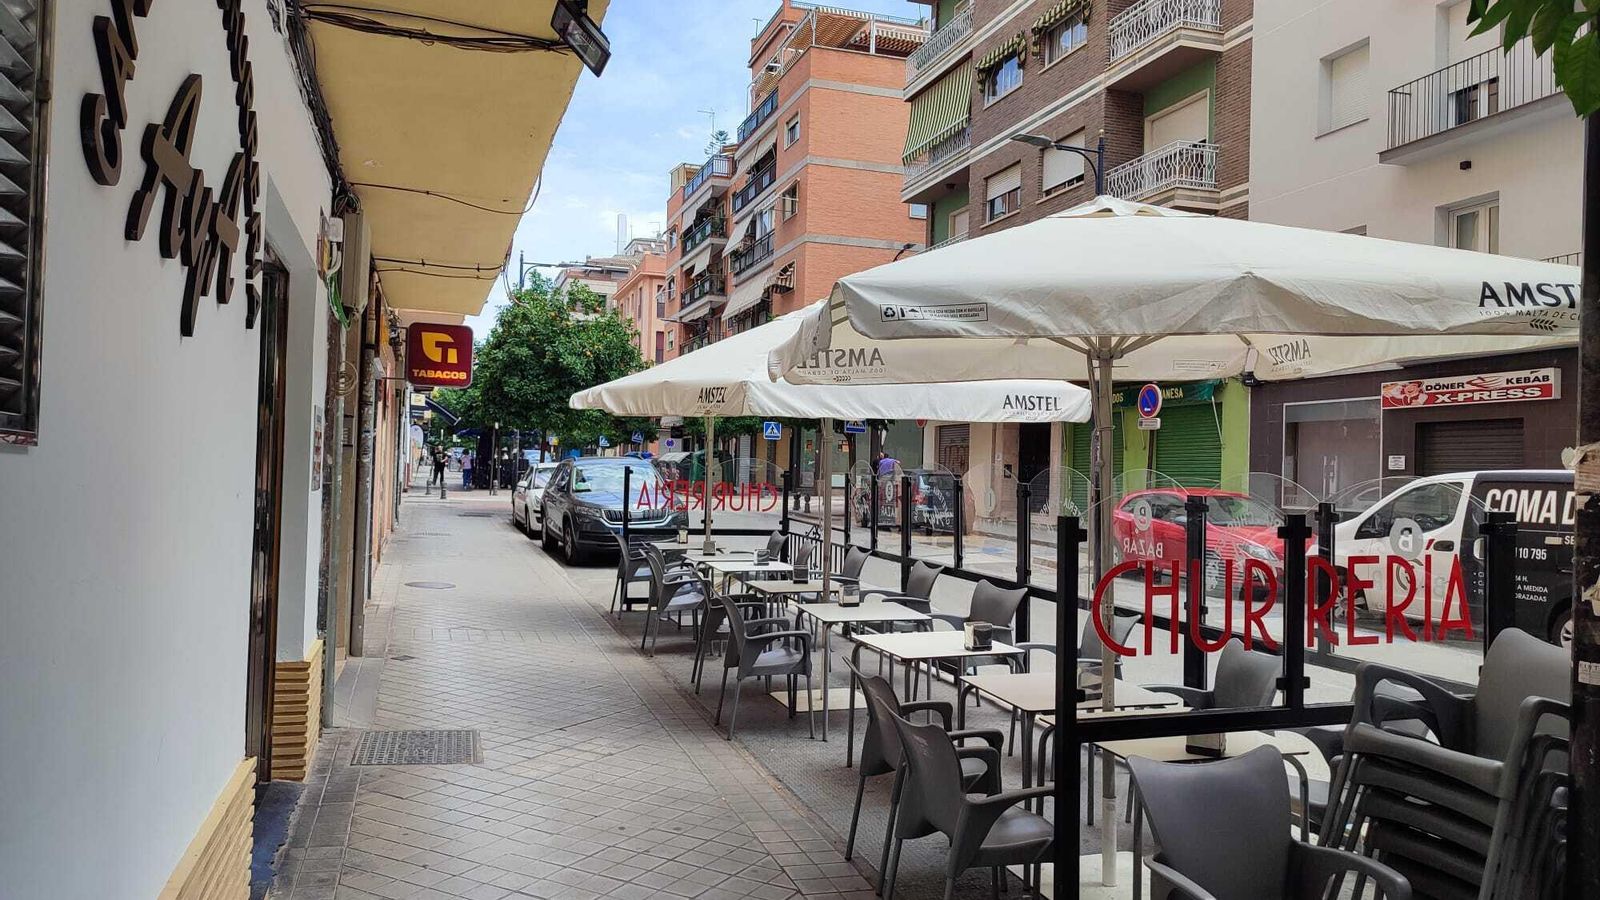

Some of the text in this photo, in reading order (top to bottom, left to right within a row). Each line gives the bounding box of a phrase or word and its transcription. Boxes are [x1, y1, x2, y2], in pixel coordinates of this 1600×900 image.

[1478, 281, 1581, 309] AMST
[1516, 310, 1549, 318] MALTA
[1552, 311, 1566, 319] DE
[412, 369, 467, 381] TABACOS
[1425, 374, 1550, 392] DÖNER KEBAB
[697, 386, 727, 404] AMSTEL
[1003, 394, 1062, 412] AMSTEL
[1434, 387, 1542, 404] X-PRESS
[1485, 489, 1558, 524] COMA
[1530, 548, 1547, 561] 795
[1092, 539, 1474, 657] CHURRERÍA
[1523, 585, 1548, 593] MEDIDA
